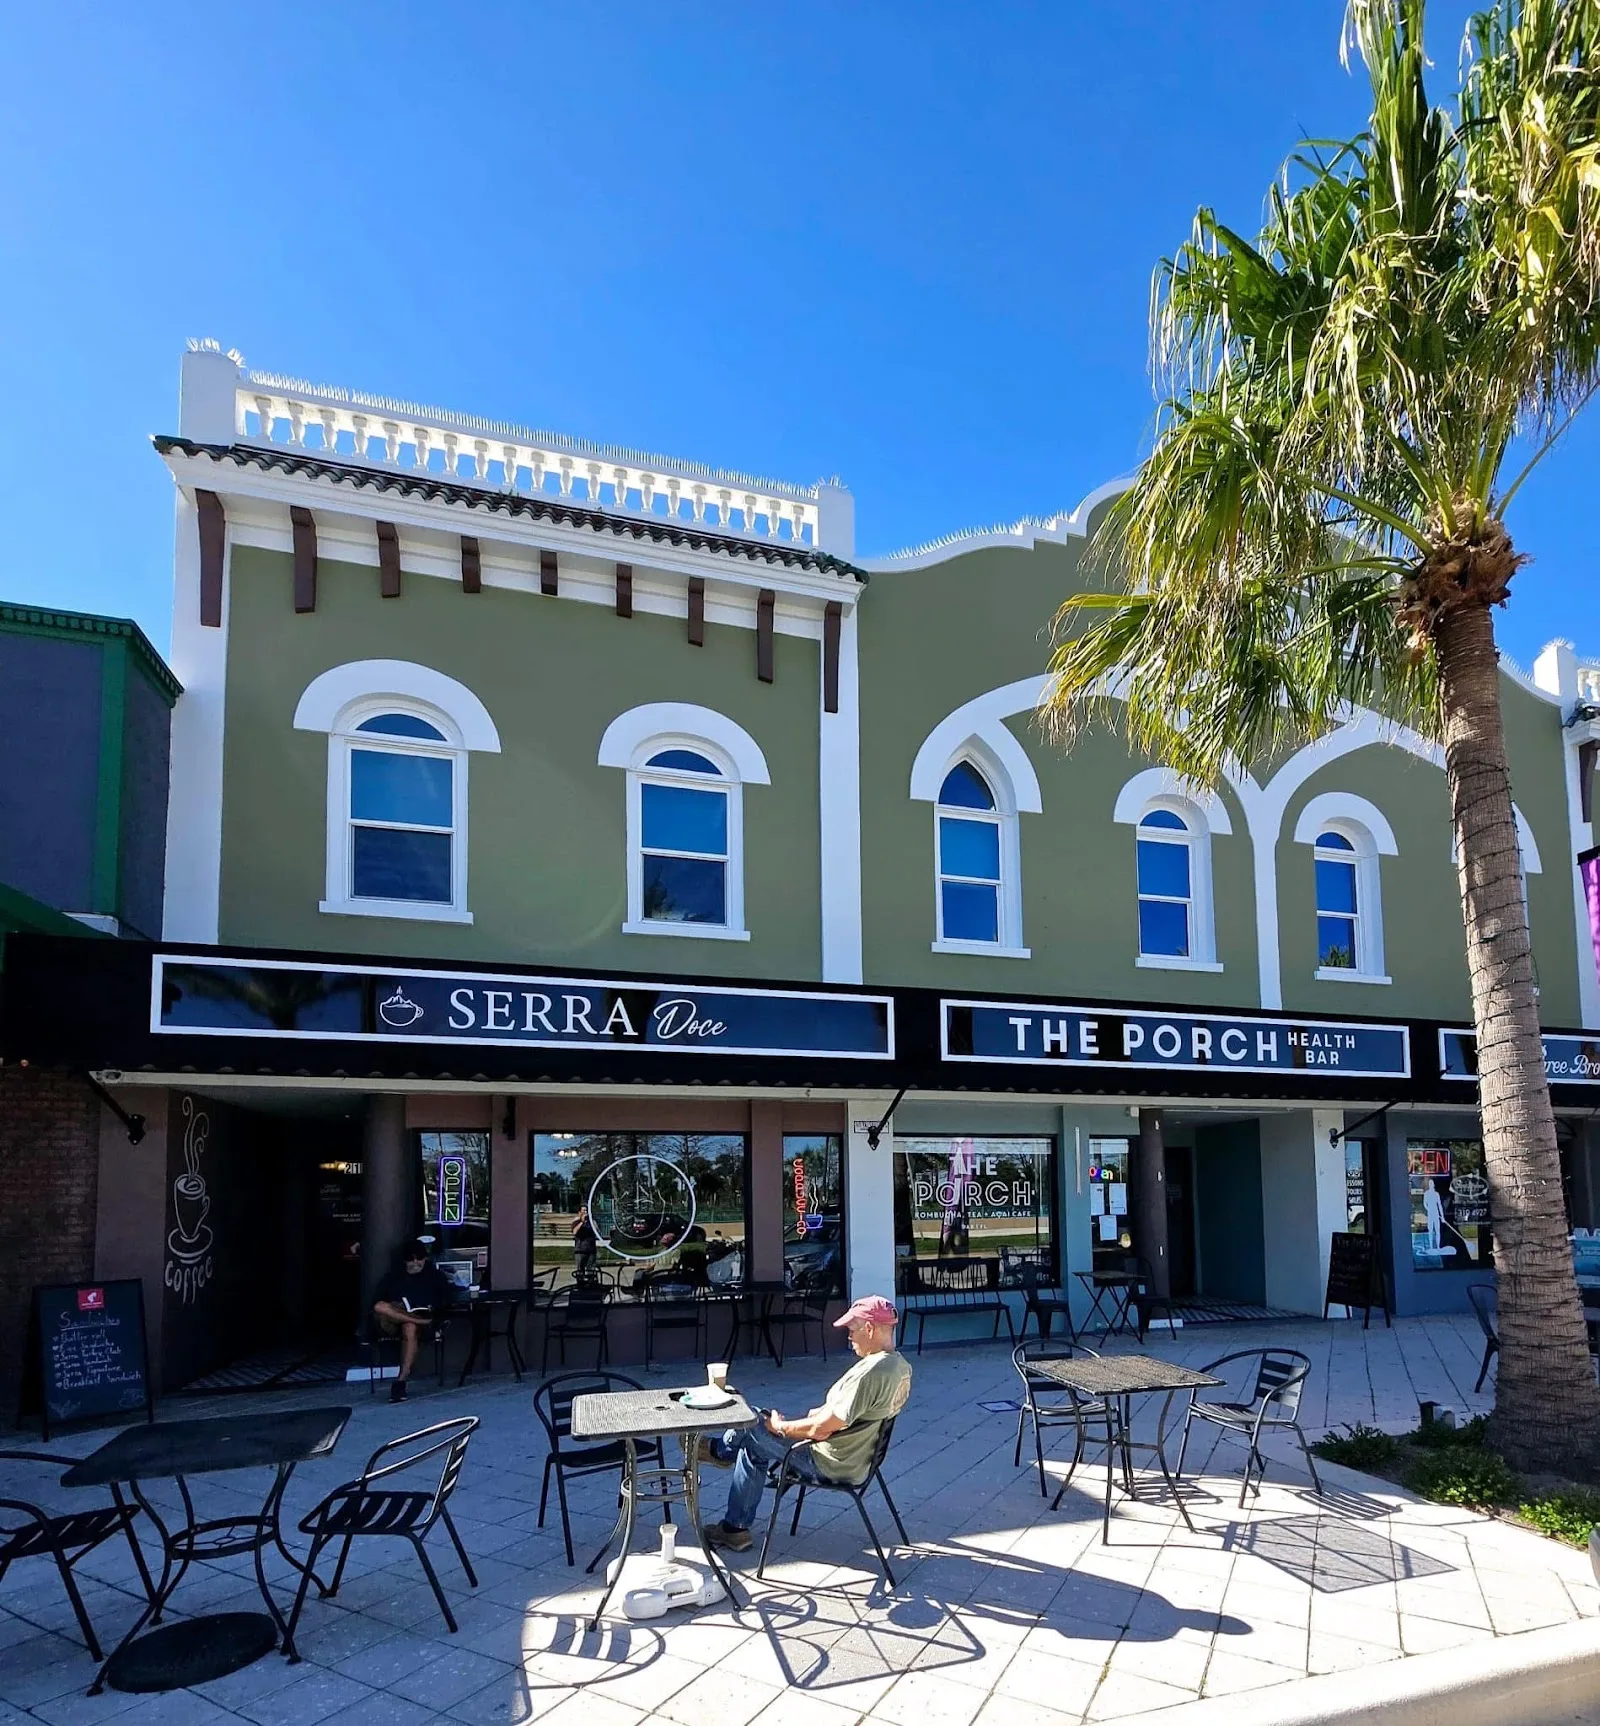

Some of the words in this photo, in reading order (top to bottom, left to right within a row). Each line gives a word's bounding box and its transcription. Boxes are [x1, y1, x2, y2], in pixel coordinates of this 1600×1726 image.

[448, 988, 639, 1036] SERRA
[653, 999, 728, 1040] Doce
[1009, 1017, 1100, 1055] THE
[1123, 1023, 1279, 1062] PORCH
[1288, 1031, 1356, 1050] HEALTH
[1305, 1050, 1340, 1065] BAR
[949, 1156, 999, 1176] THE
[444, 1160, 461, 1222] OPEN
[914, 1180, 1031, 1207] PORCH
[967, 1210, 982, 1218] TEA
